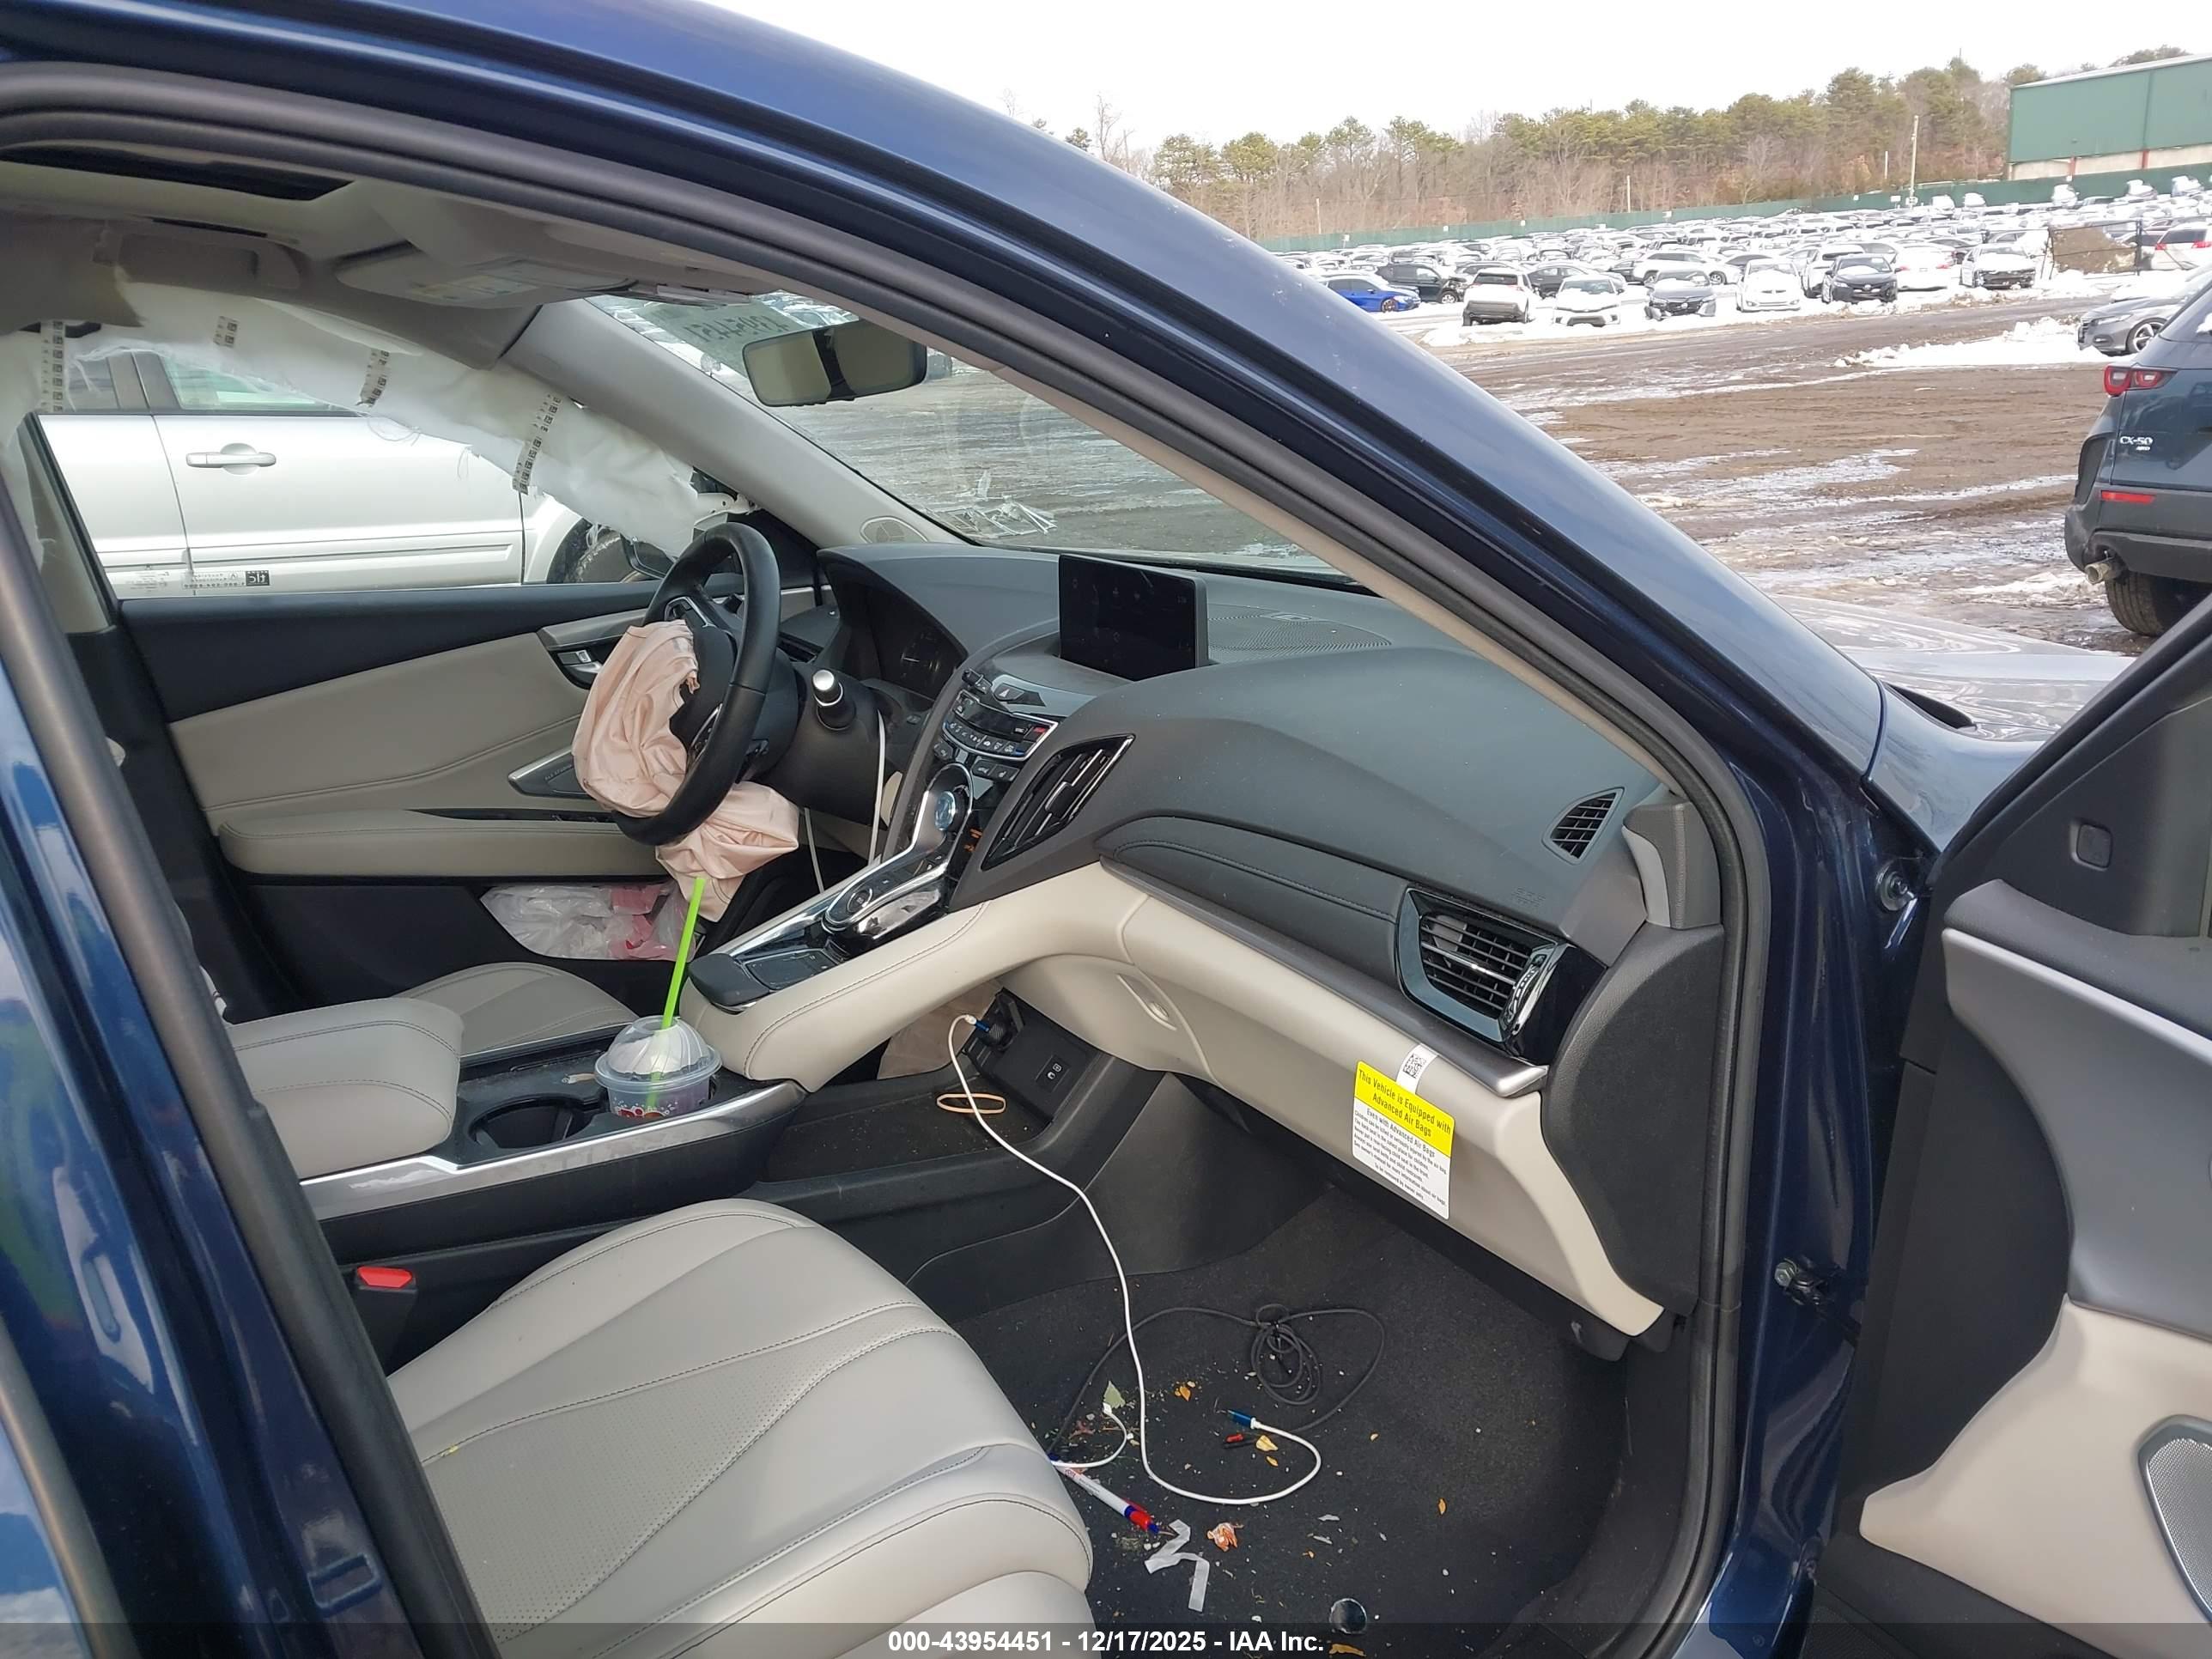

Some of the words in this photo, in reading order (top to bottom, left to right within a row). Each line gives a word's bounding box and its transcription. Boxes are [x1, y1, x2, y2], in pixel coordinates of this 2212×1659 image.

[2120, 436, 2153, 445] CX-50
[1358, 1069, 1371, 1085] This
[1373, 1079, 1395, 1099] Vehicle
[1397, 1093, 1404, 1104] is
[1404, 1097, 1435, 1125] Equipped
[1436, 1118, 1451, 1133] with
[1372, 1092, 1403, 1118] Advanced
[1403, 1112, 1414, 1125] Air
[1415, 1119, 1432, 1138] Bags
